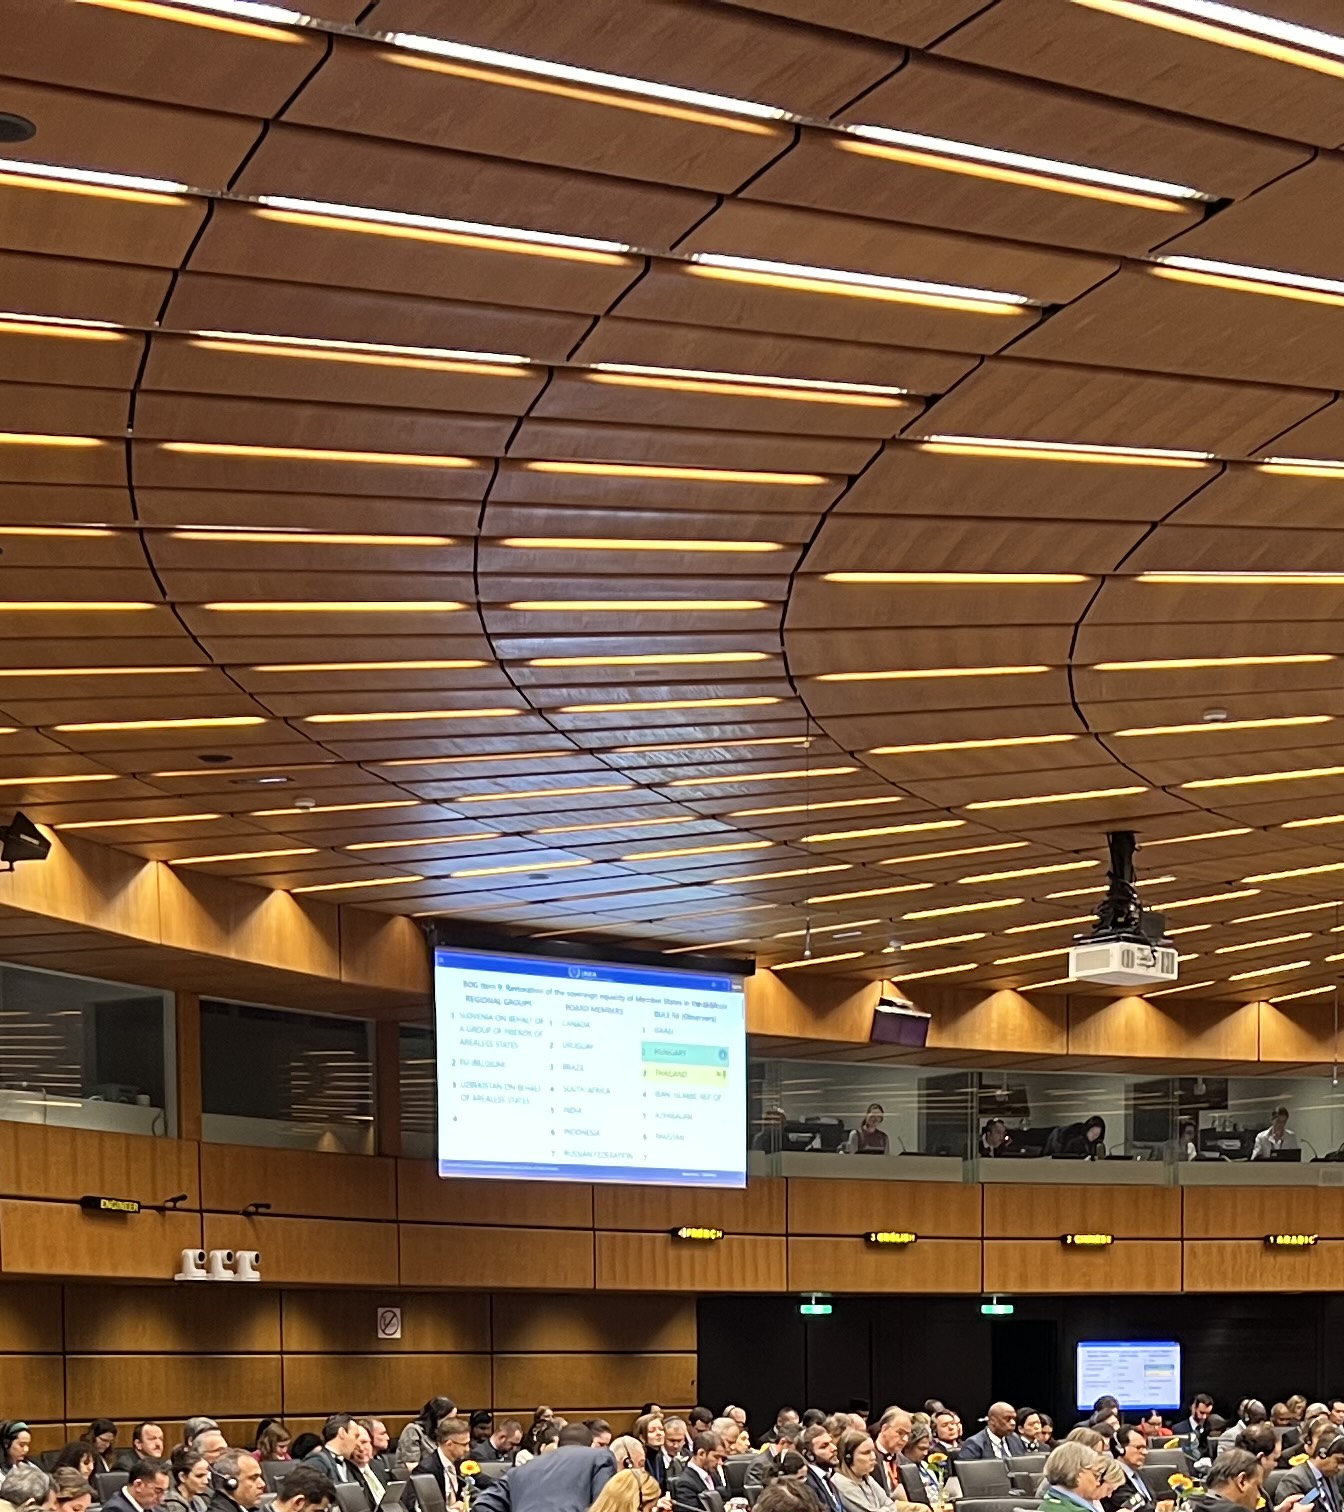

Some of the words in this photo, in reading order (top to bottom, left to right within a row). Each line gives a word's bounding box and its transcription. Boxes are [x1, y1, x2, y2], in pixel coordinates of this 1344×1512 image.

[466, 995, 501, 1005] REGIONAL
[504, 998, 532, 1006] GROUPS
[566, 1004, 589, 1012] BOARD
[591, 1005, 623, 1015] MEMBERS
[509, 1015, 532, 1023] BEHALF
[496, 1041, 518, 1049] STATES
[1276, 1235, 1316, 1244] ARABIC
